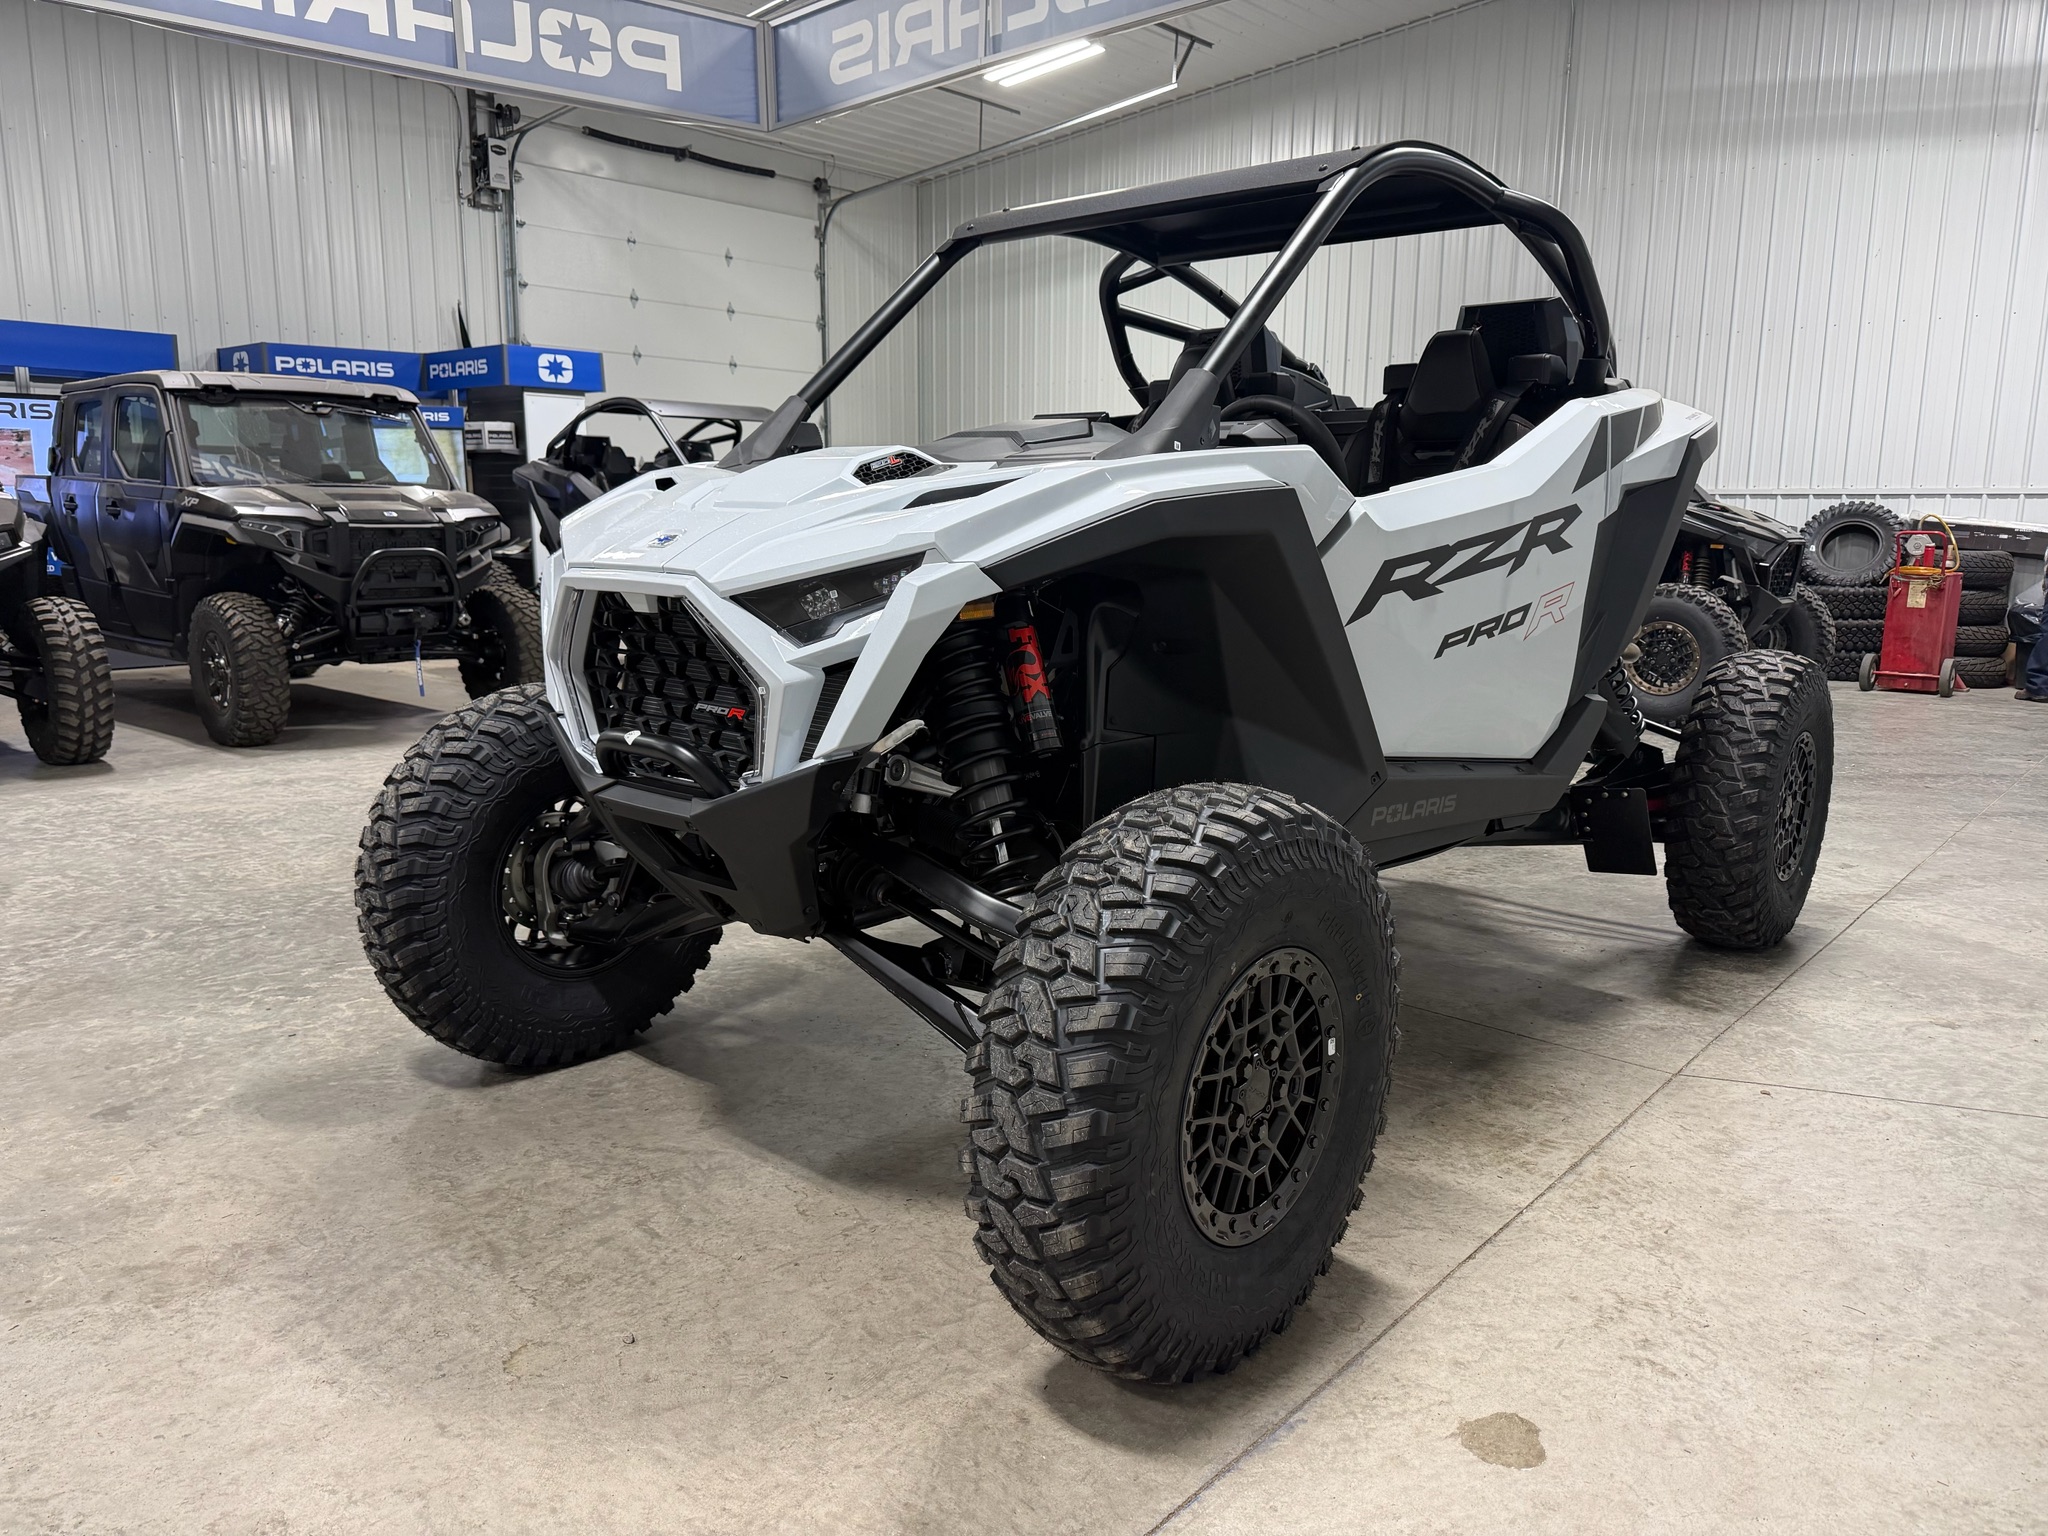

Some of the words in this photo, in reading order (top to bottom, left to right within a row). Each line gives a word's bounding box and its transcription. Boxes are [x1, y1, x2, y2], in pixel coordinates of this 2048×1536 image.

[275, 356, 395, 378] POLARIS
[429, 358, 488, 379] POLARIS
[181, 496, 199, 507] XP
[1344, 503, 1583, 627] RZR
[1434, 602, 1533, 660] PRO
[1523, 581, 1575, 641] R
[1007, 625, 1051, 703] FOX
[1370, 794, 1458, 827] POLARIS
